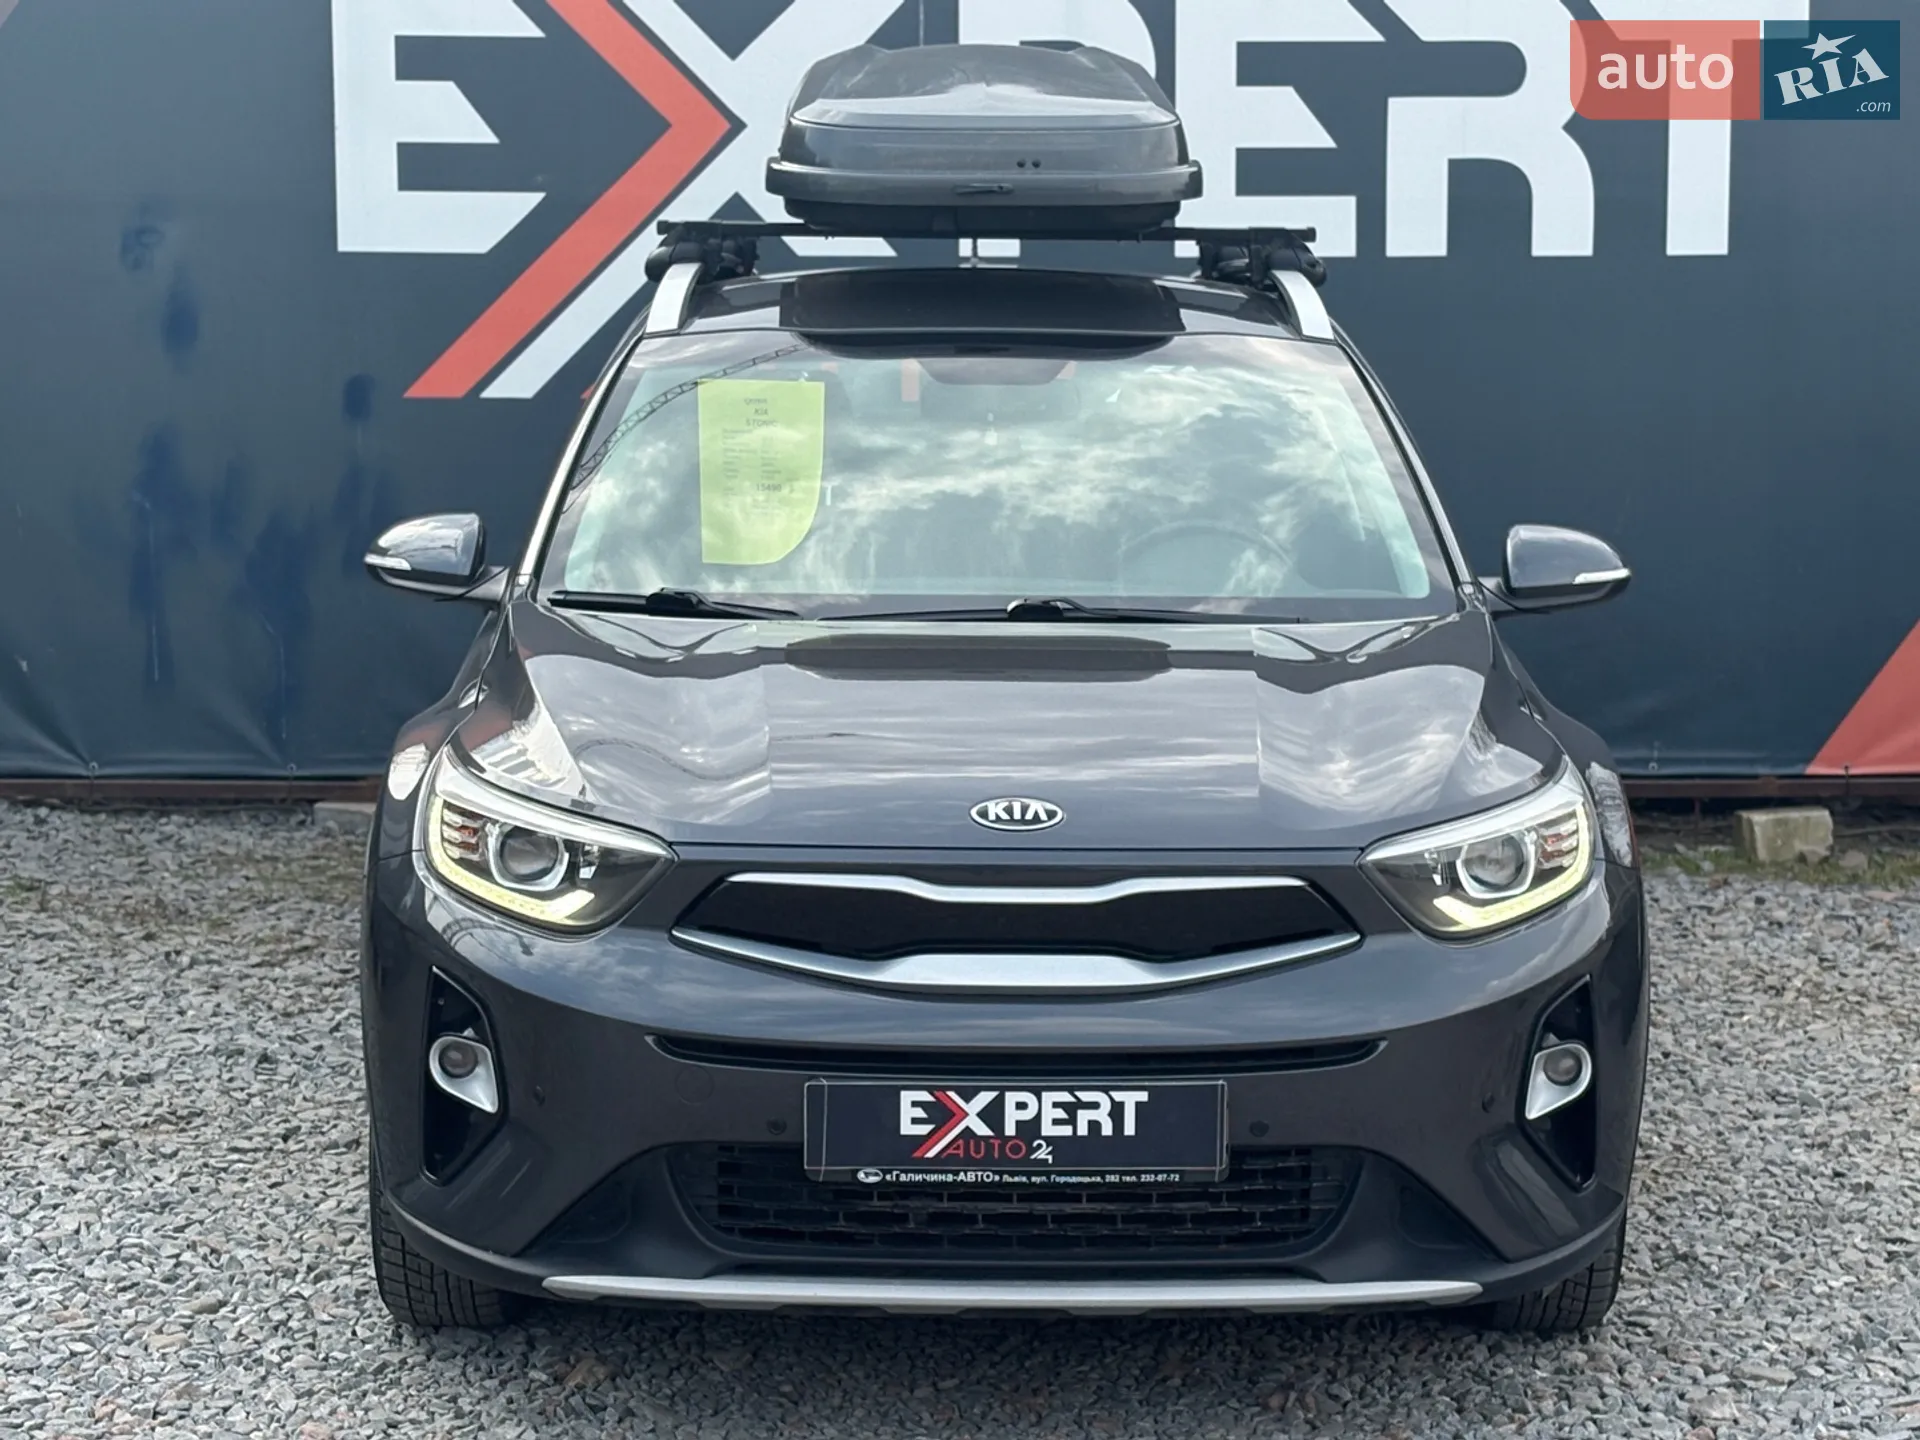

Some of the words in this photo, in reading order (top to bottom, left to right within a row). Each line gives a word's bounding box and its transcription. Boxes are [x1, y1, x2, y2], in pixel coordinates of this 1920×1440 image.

[331, 0, 1810, 398] EXERT
[986, 800, 1049, 822] KIA
[899, 1090, 1149, 1158] EXPERT
[884, 1170, 1001, 1183] «Галичина-АВТО»
